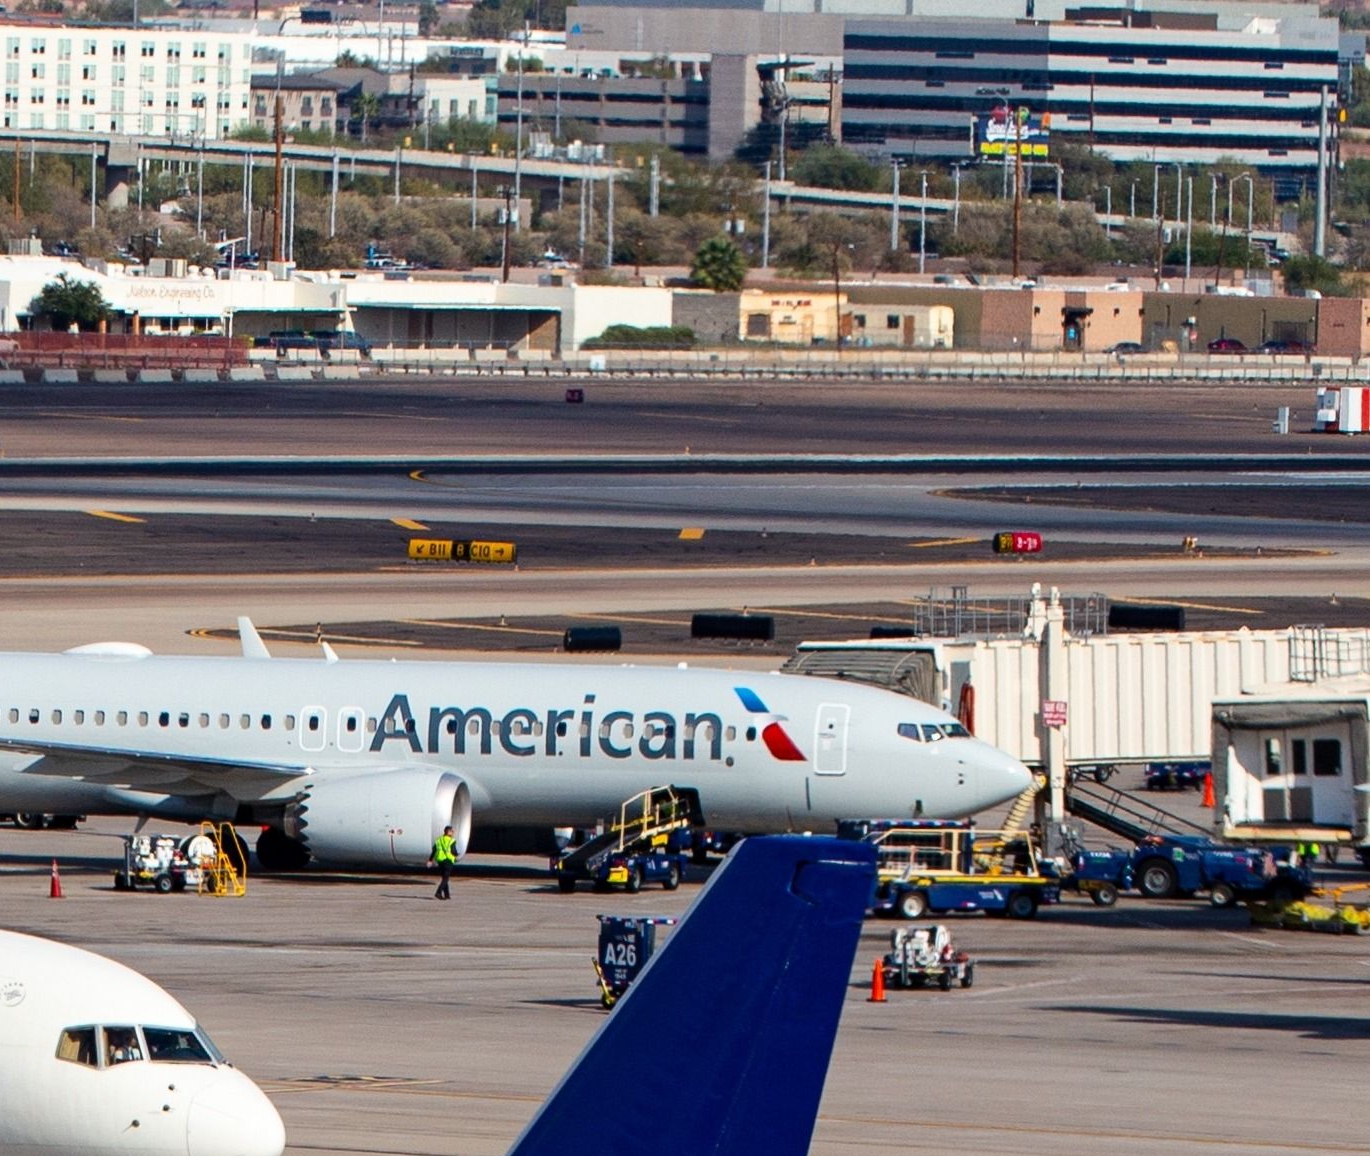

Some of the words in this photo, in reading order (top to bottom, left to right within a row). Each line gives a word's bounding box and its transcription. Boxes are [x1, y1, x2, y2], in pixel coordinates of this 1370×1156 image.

[429, 543, 446, 557] B11
[471, 545, 491, 558] C10
[368, 694, 724, 761] American
[604, 942, 637, 967] A26
